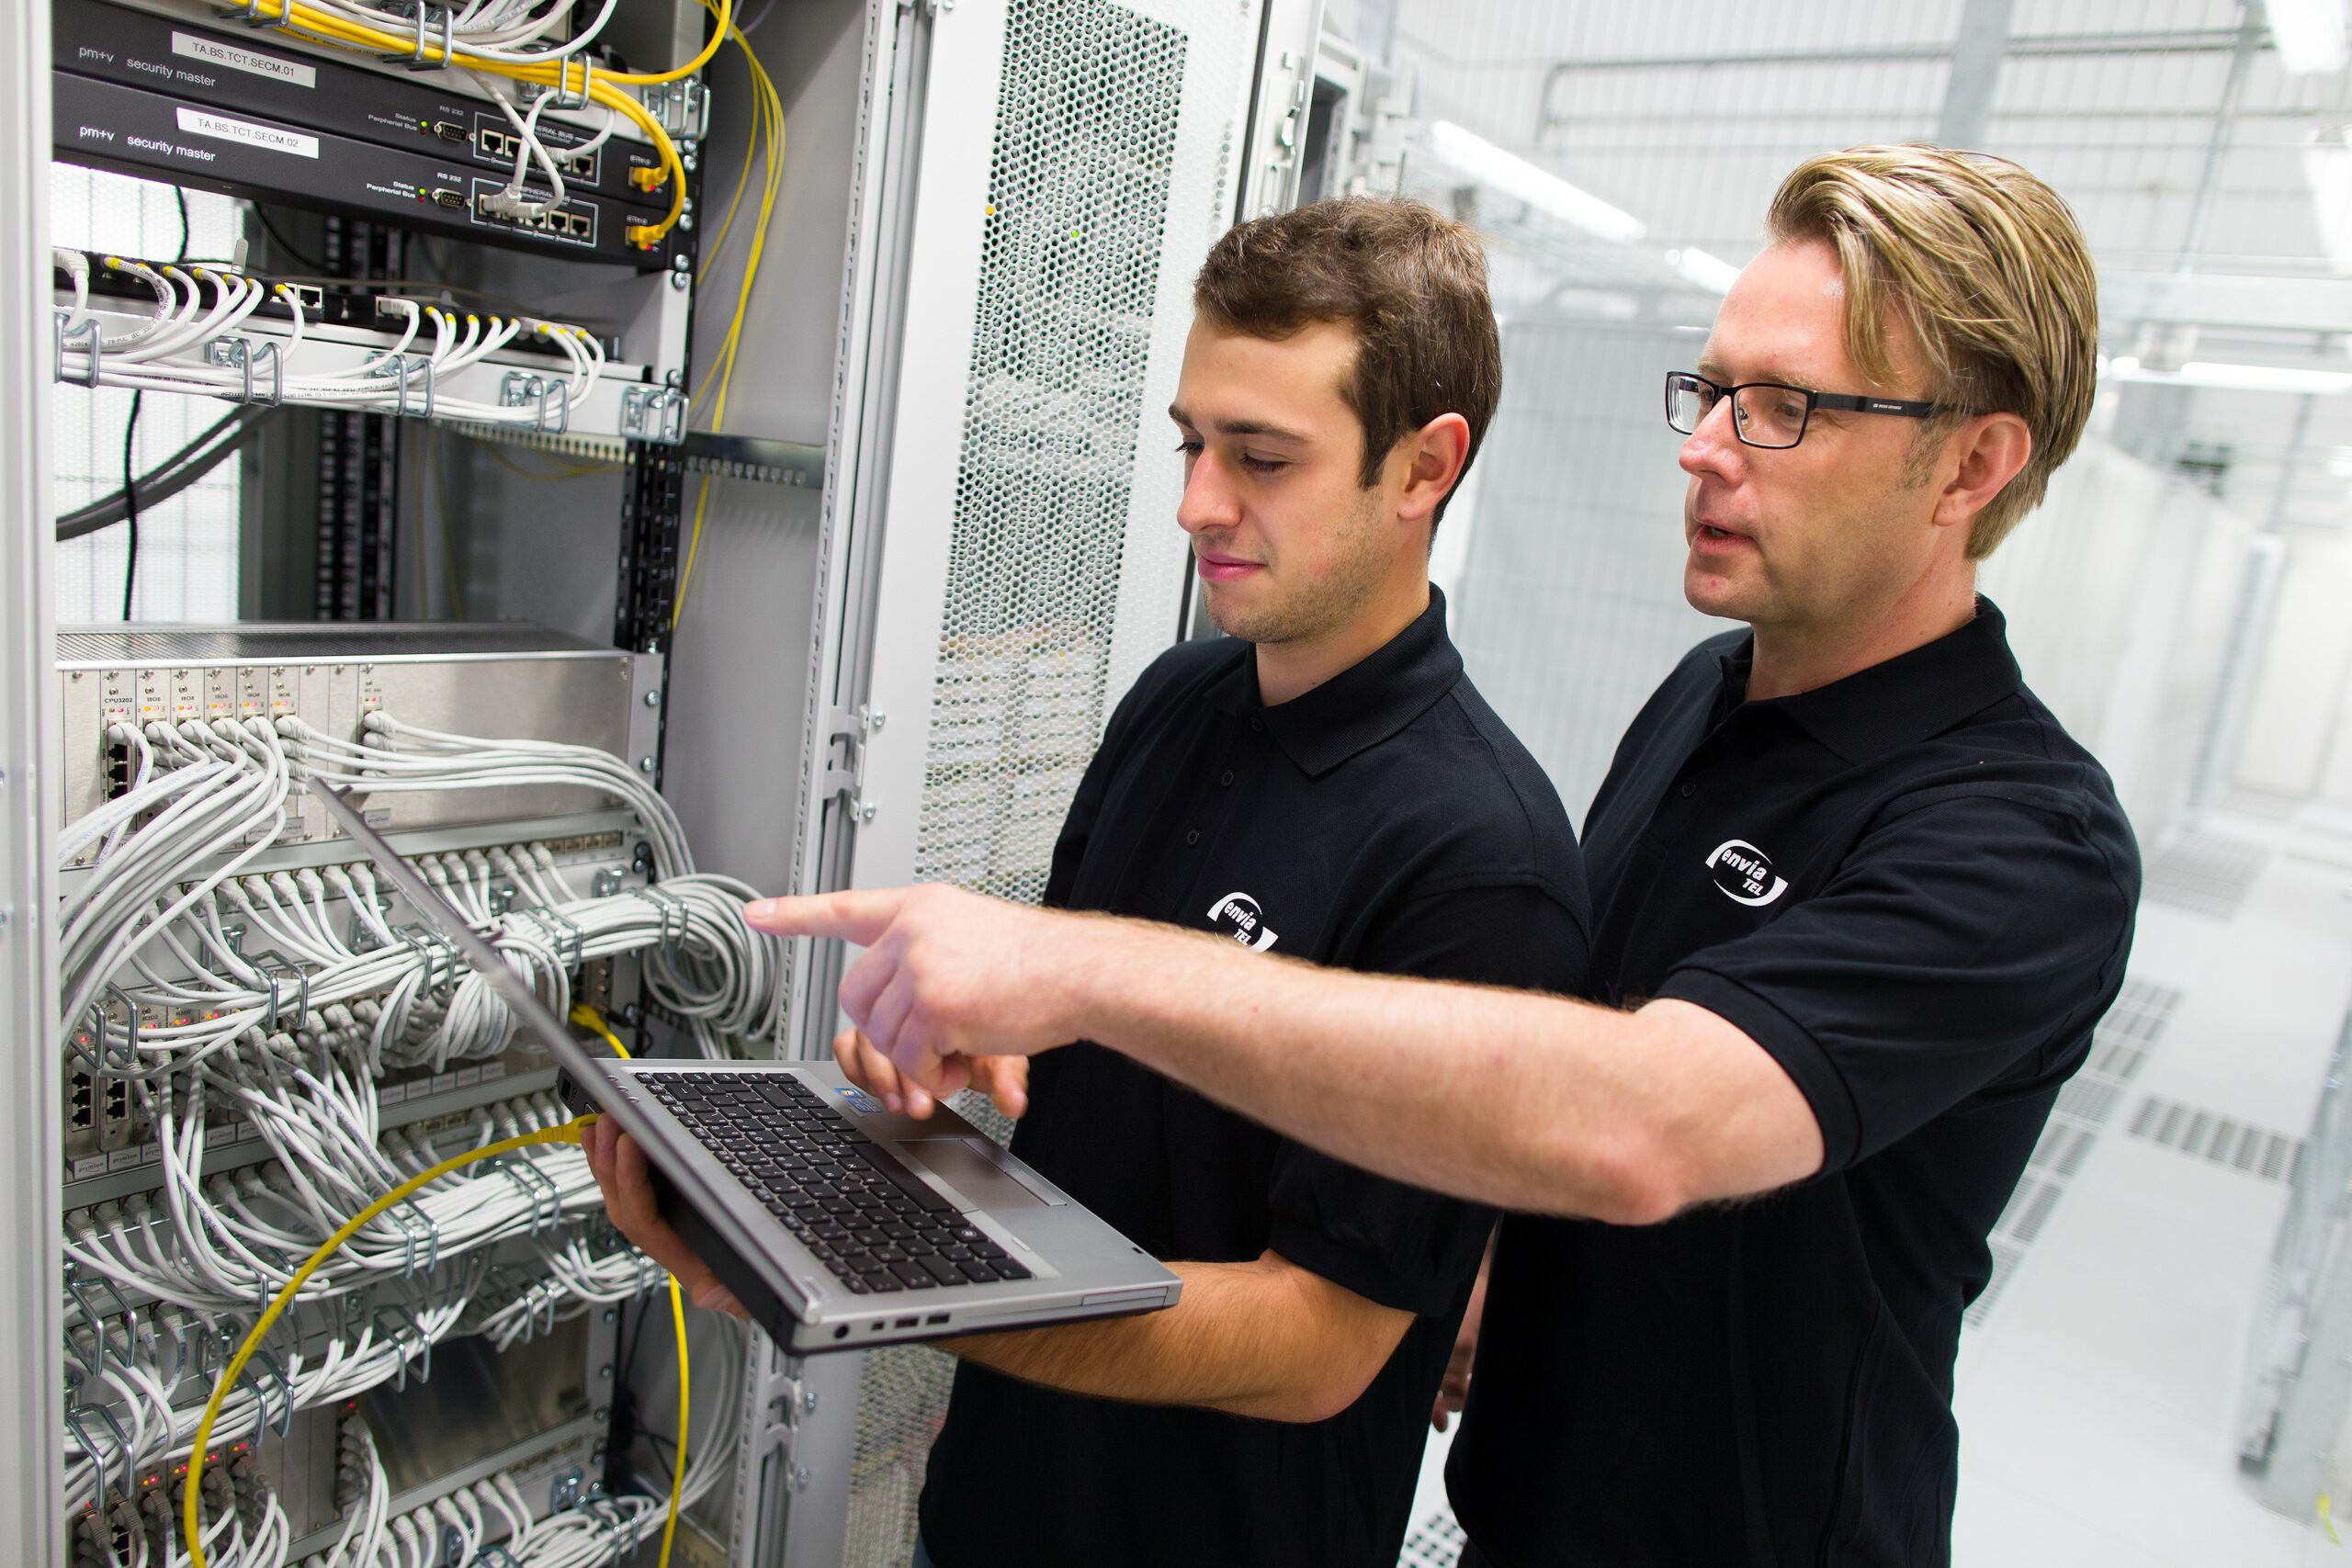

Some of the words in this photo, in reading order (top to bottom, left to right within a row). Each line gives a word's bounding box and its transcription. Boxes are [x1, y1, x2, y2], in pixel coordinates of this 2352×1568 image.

[78, 47, 115, 64] pm+v
[192, 42, 295, 77] TA.BS.TCT.SECM.01
[126, 58, 174, 79] security
[176, 71, 216, 87] master
[394, 112, 416, 123] Status
[404, 122, 418, 131] Bus
[79, 125, 115, 141] pm+v
[197, 118, 300, 149] TA.BS.TCT.SECM.02
[127, 134, 174, 156] security
[176, 145, 216, 163] master
[392, 180, 415, 191] Status
[402, 190, 416, 199] Bus
[1721, 849, 1768, 882] envia
[1742, 877, 1764, 897] TEL
[1224, 901, 1257, 931] envia
[1233, 928, 1252, 946] TEL
